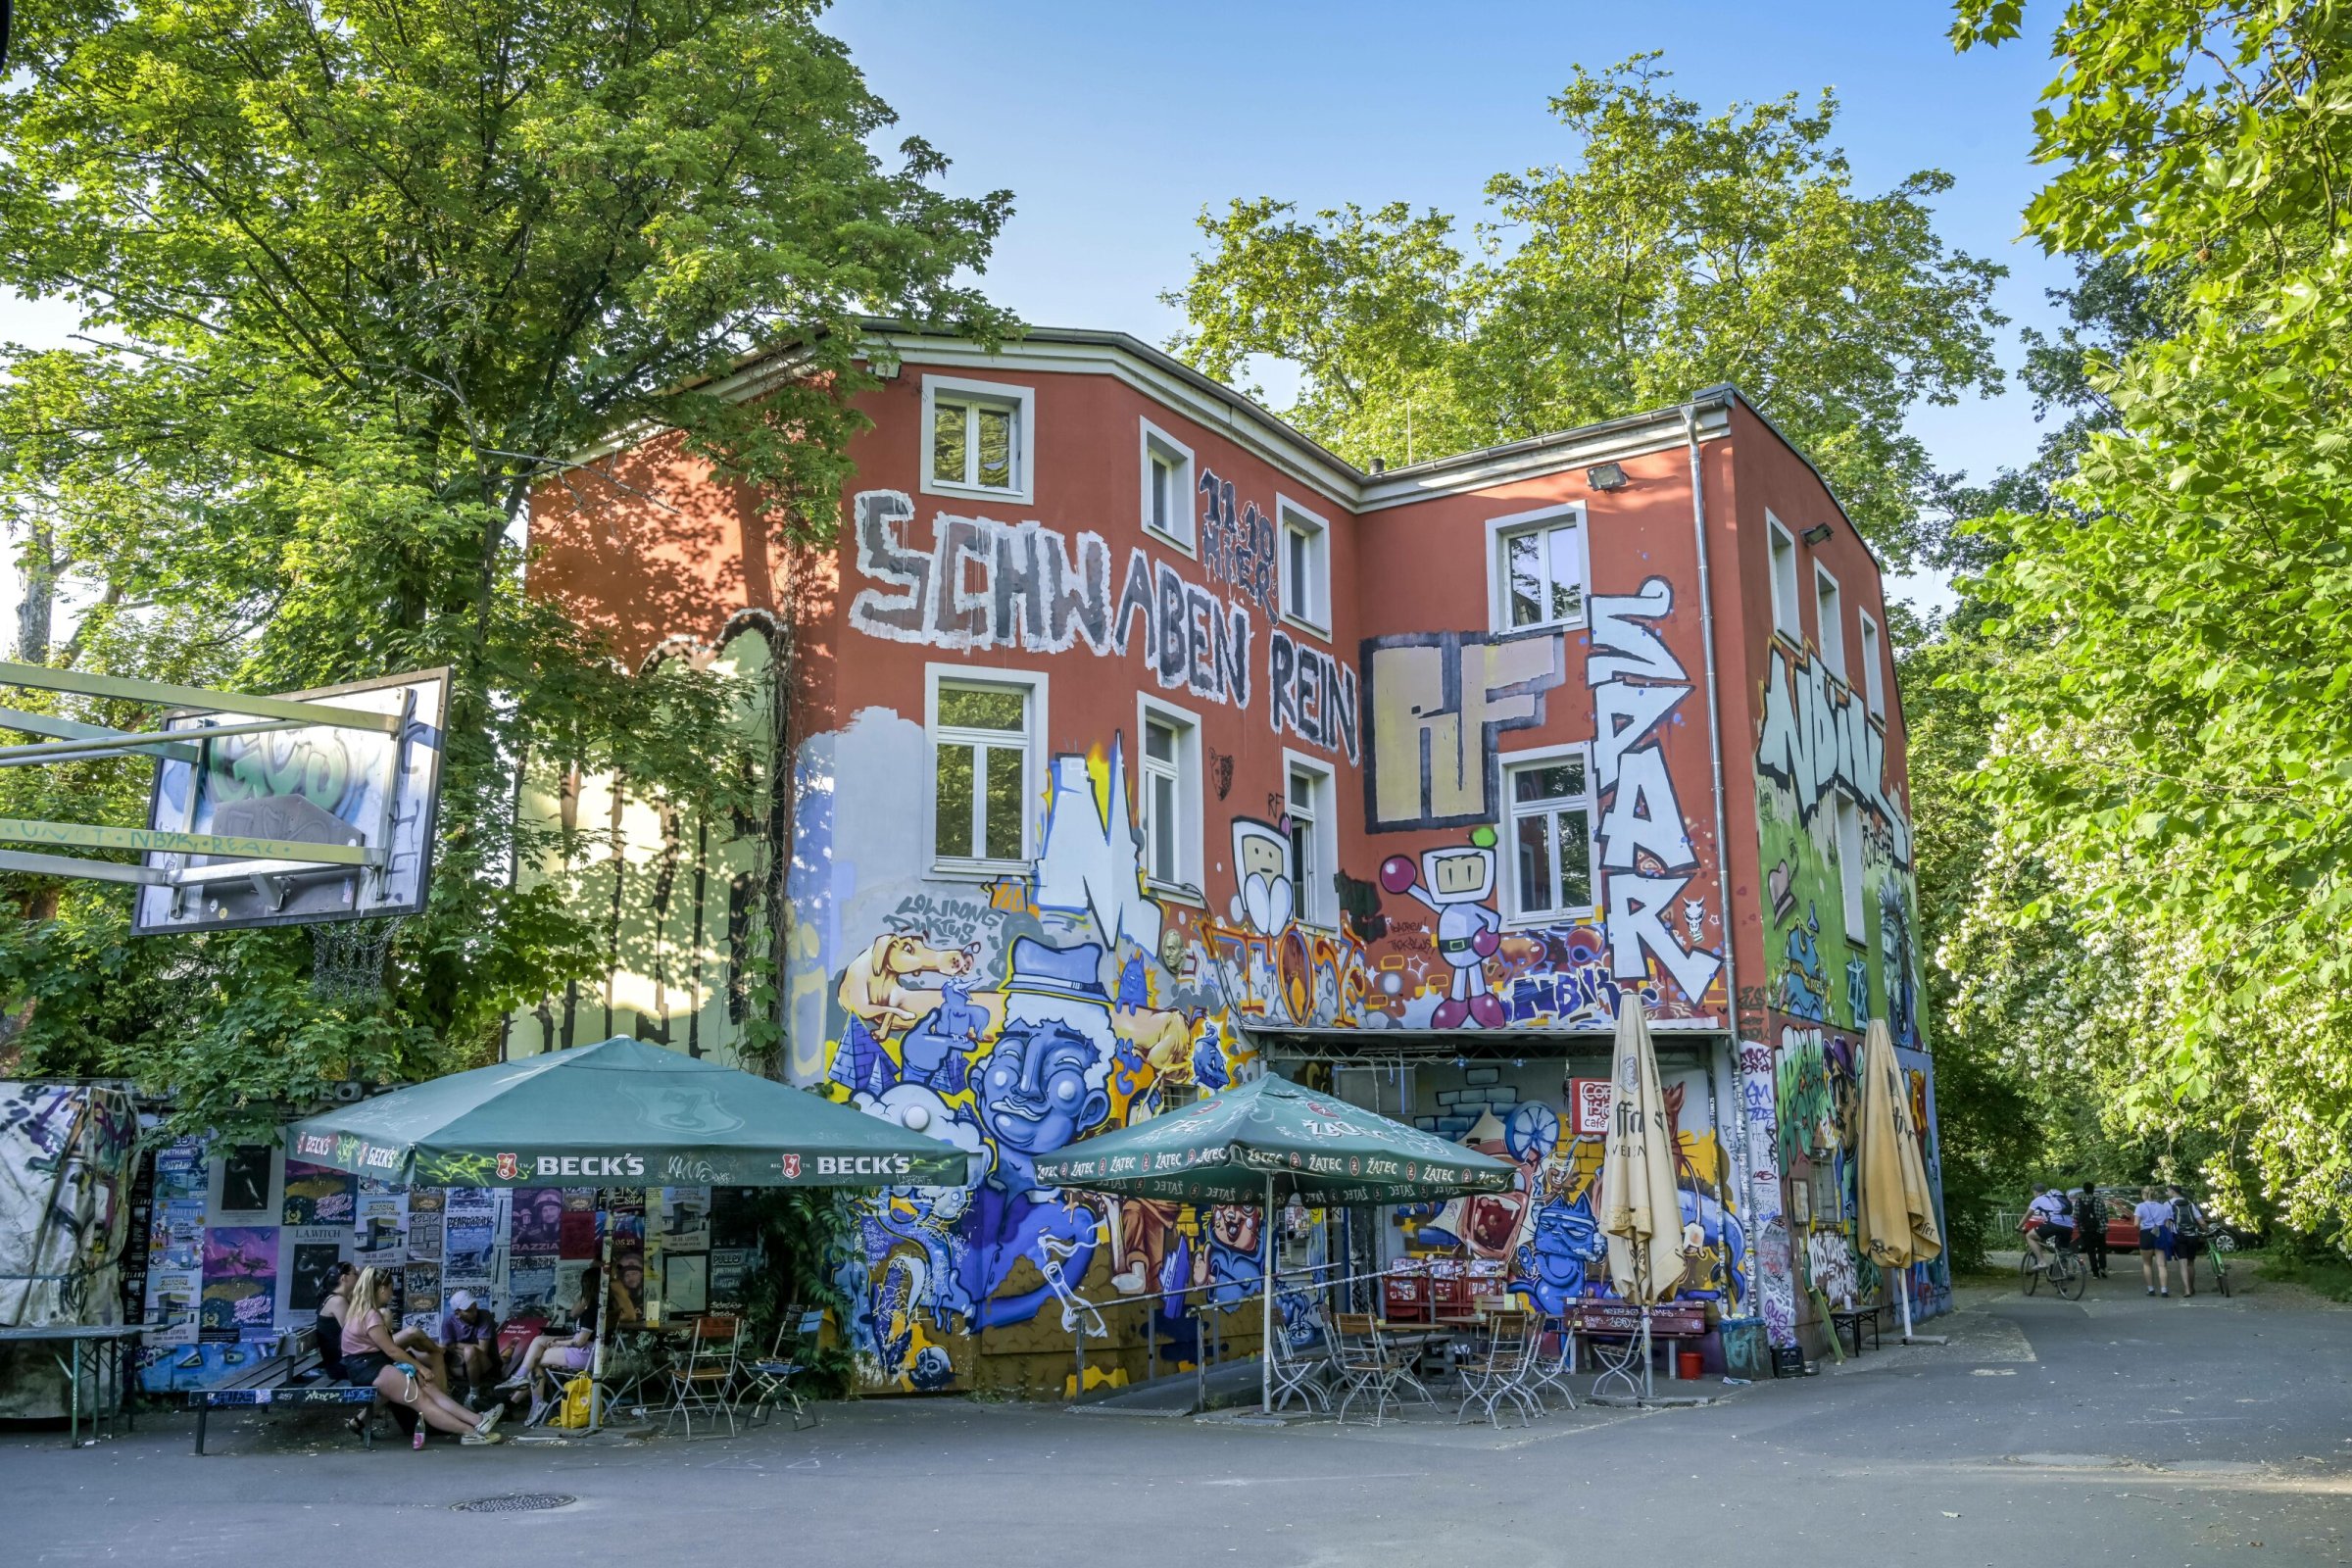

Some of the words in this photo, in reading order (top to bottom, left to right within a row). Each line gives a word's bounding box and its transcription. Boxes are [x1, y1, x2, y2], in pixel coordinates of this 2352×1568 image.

[536, 1152, 645, 1176] BECK'S
[816, 1152, 909, 1175] BECK'S
[1109, 1155, 1137, 1172] ŽATEC
[1154, 1152, 1182, 1169] ŽATEC
[1307, 1153, 1344, 1172] ŽATEC
[1366, 1157, 1398, 1175] ŽATEC
[1423, 1164, 1455, 1182] ŽATEC
[511, 1243, 560, 1252] RAZZIA
